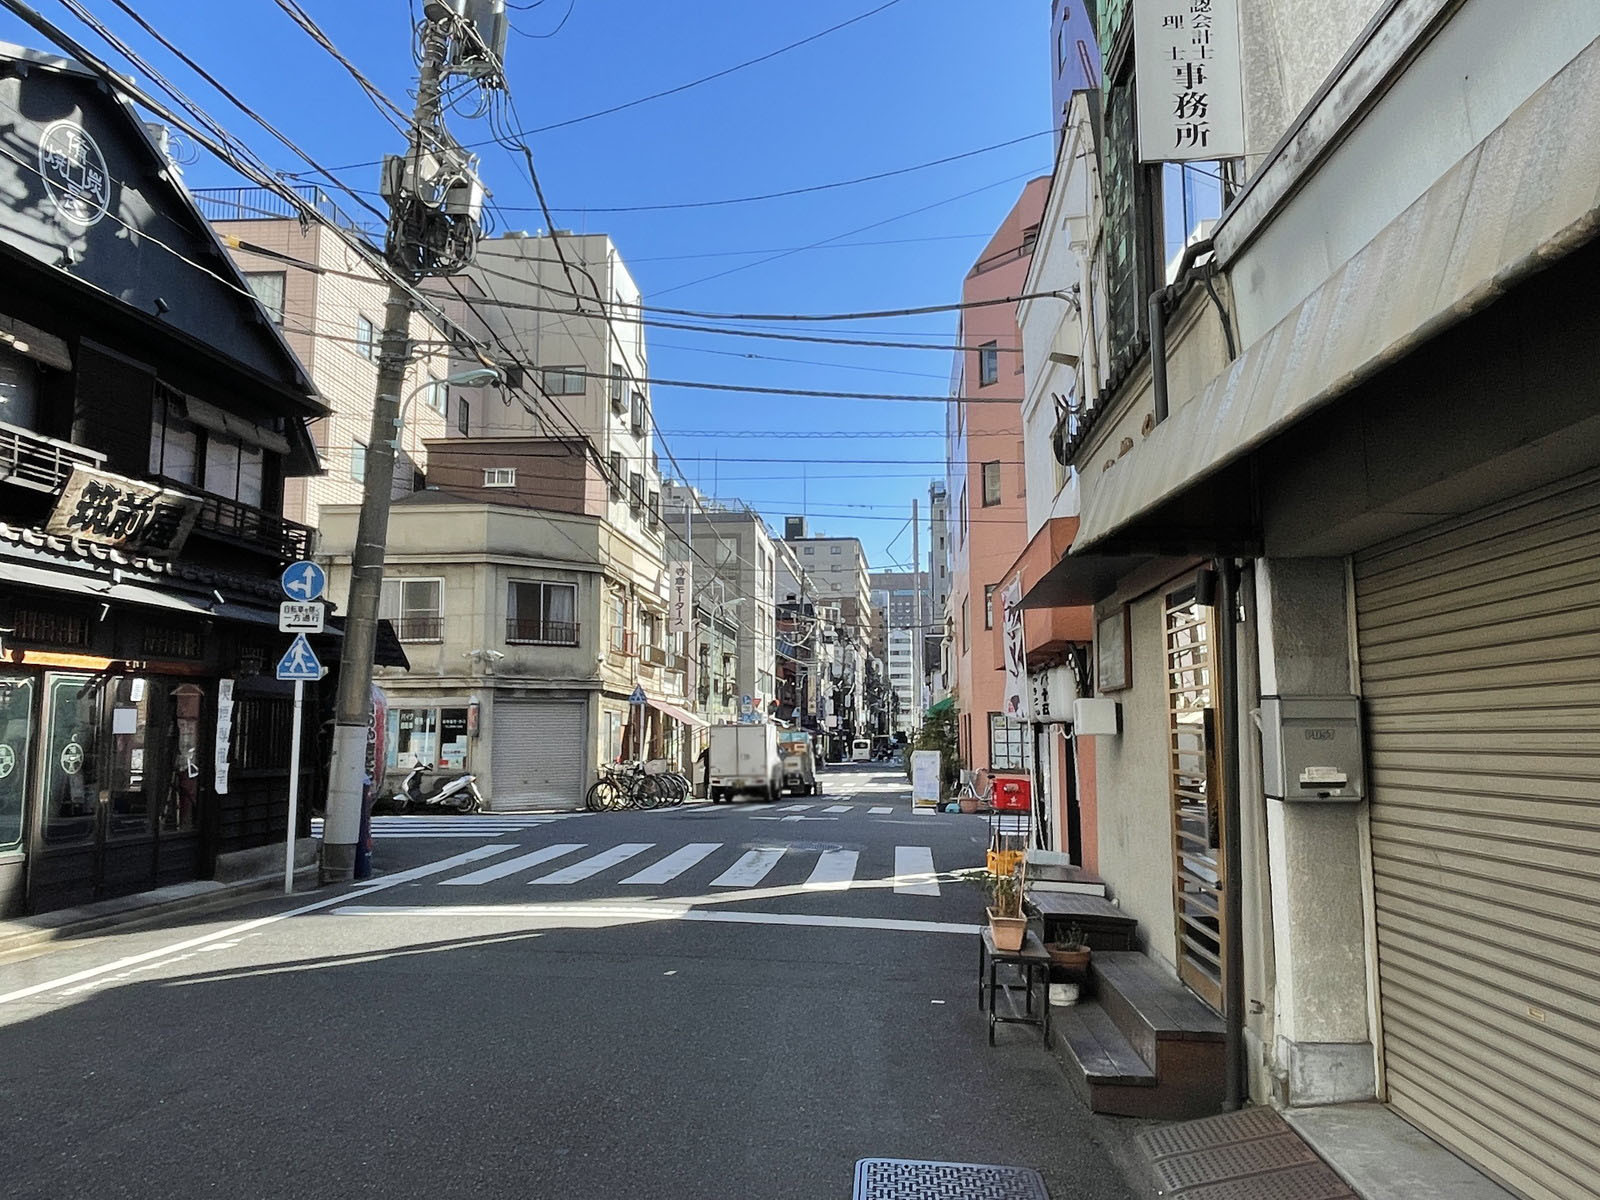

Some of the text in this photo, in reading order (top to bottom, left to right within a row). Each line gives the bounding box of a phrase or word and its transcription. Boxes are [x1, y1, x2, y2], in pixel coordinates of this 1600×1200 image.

[1172, 62, 1210, 149] 事務所
[284, 614, 319, 622] 一方通行
